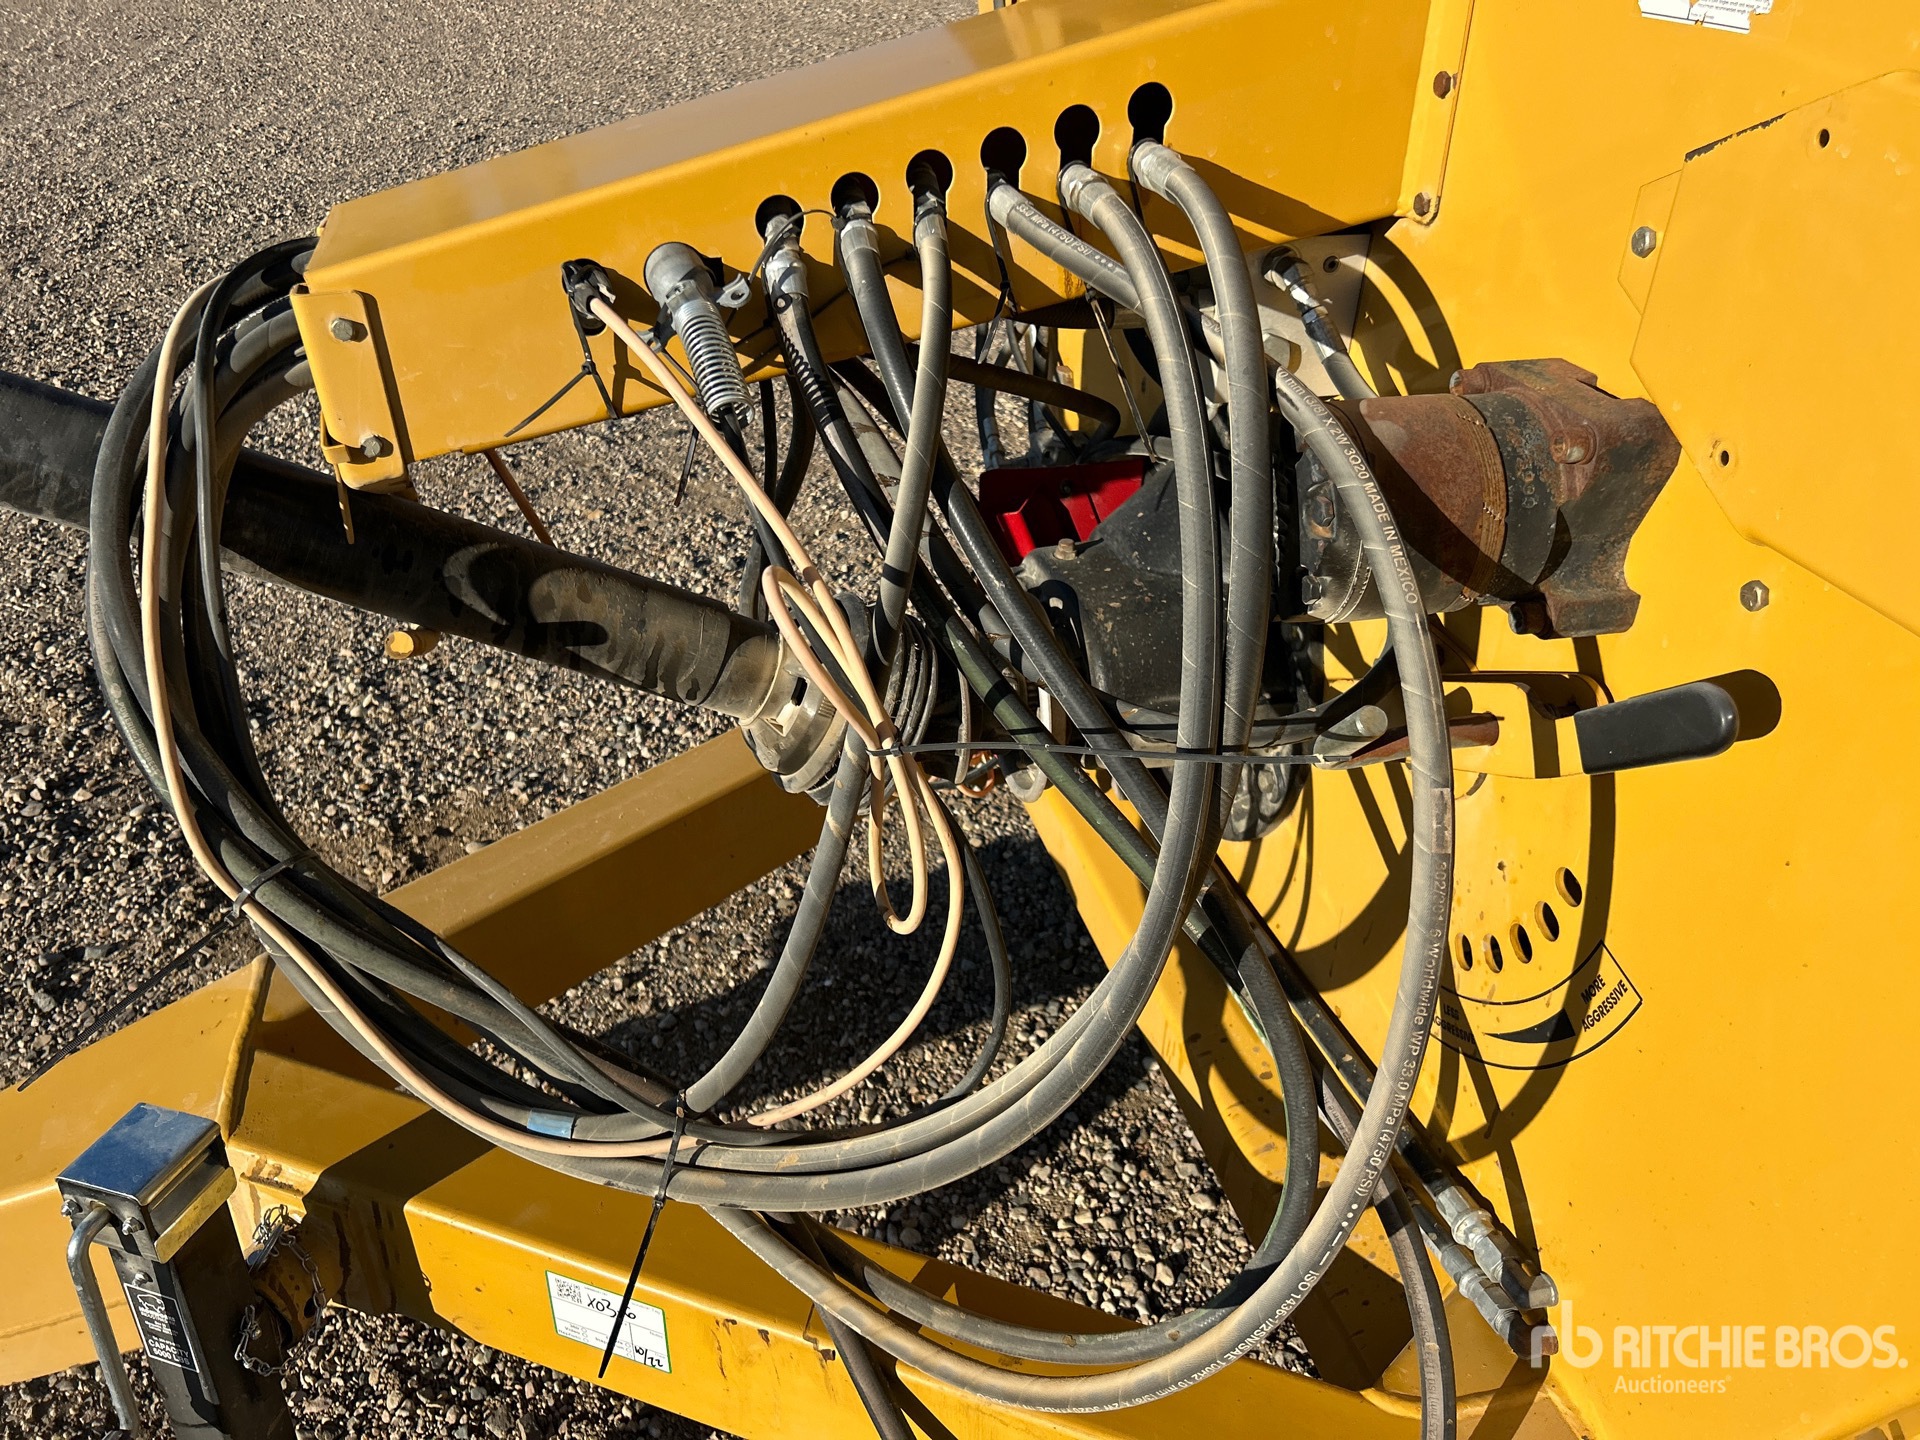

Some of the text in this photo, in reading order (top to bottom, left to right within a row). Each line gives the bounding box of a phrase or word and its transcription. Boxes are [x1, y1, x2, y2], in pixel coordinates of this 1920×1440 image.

[1285, 375, 1305, 396] mm
[1303, 394, 1328, 418] (3/8)
[1322, 417, 1336, 427] X
[1330, 428, 1351, 446] 2W
[1343, 447, 1370, 480] 3Q20
[1362, 481, 1391, 523] MADE
[1382, 525, 1398, 541] IN
[1389, 544, 1418, 605] MEXICO
[1413, 942, 1443, 1026] Worldwide
[1581, 973, 1607, 1003] MORE
[1582, 979, 1630, 1032] AGGRESSIVE
[1407, 1030, 1425, 1057] WP
[1385, 1093, 1408, 1126] MPa
[1369, 1129, 1396, 1168] (4750
[1354, 1167, 1378, 1198] PSI)
[1297, 1270, 1320, 1292] ISO
[148, 1339, 189, 1358] CAPACITY
[171, 1353, 190, 1366] LBS
[1155, 1382, 1178, 1397] mm
